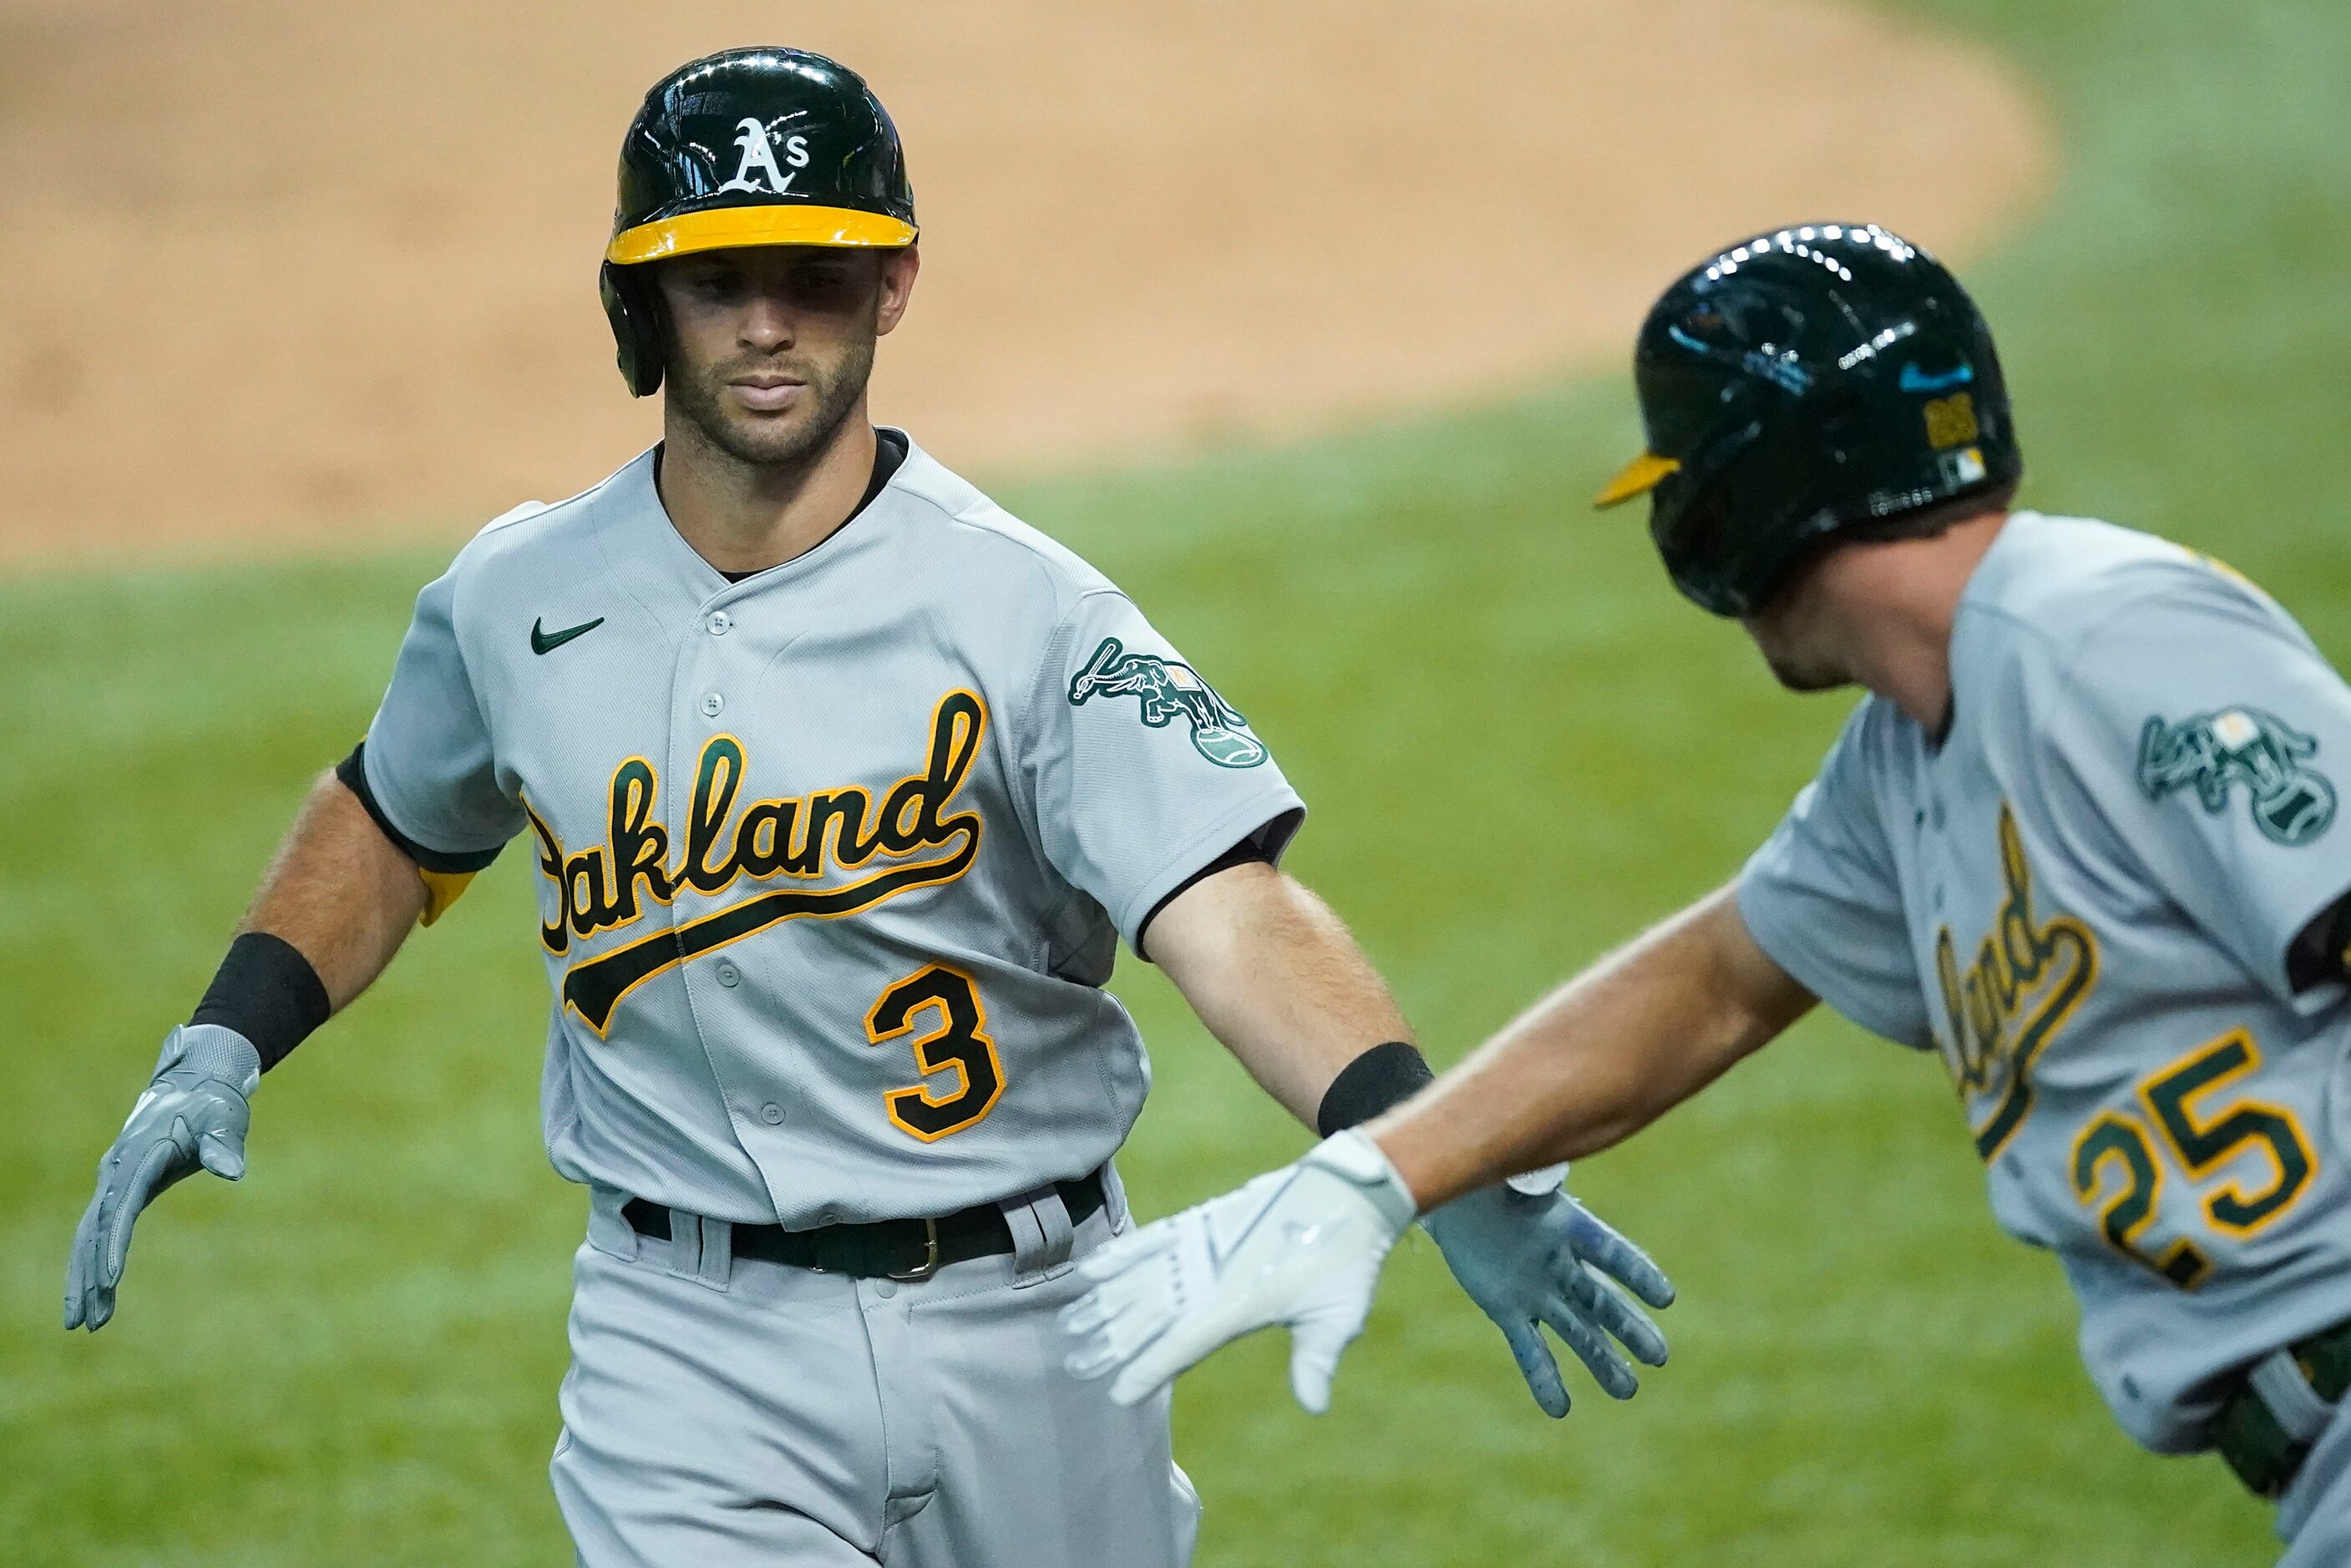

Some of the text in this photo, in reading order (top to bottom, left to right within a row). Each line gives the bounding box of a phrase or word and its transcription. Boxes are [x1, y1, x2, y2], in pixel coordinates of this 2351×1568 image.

[718, 117, 810, 194] A's
[864, 961, 1006, 1143] 3
[2069, 1025, 2319, 1292] 25
